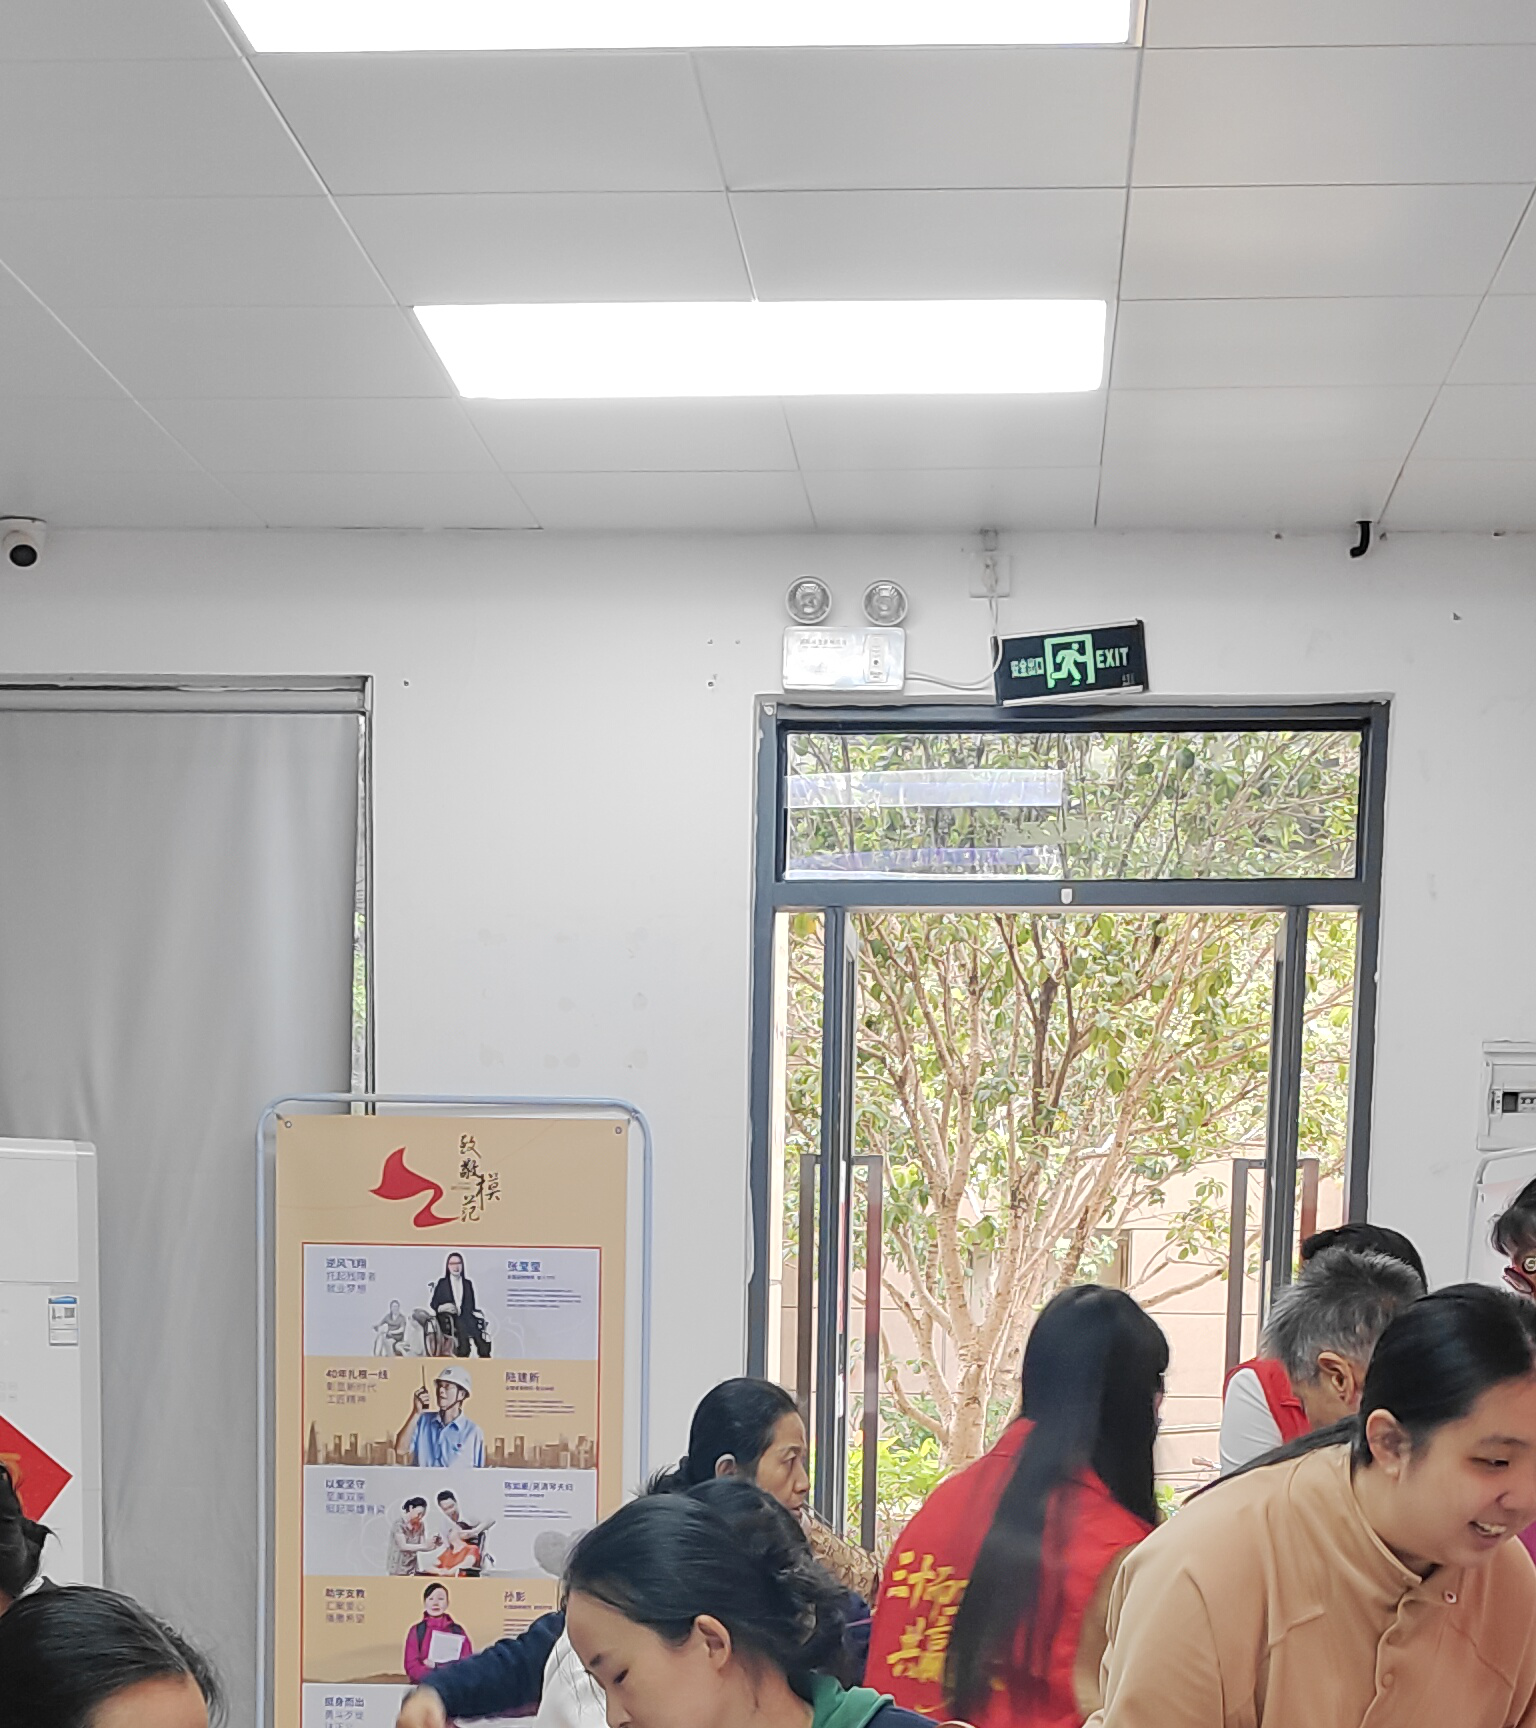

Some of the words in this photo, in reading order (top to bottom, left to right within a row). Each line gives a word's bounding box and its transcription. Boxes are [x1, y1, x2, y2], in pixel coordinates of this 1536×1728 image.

[1096, 646, 1129, 670] EXIT
[326, 1369, 388, 1380] 40年扎根一线
[325, 1479, 365, 1490] 以爱坚守
